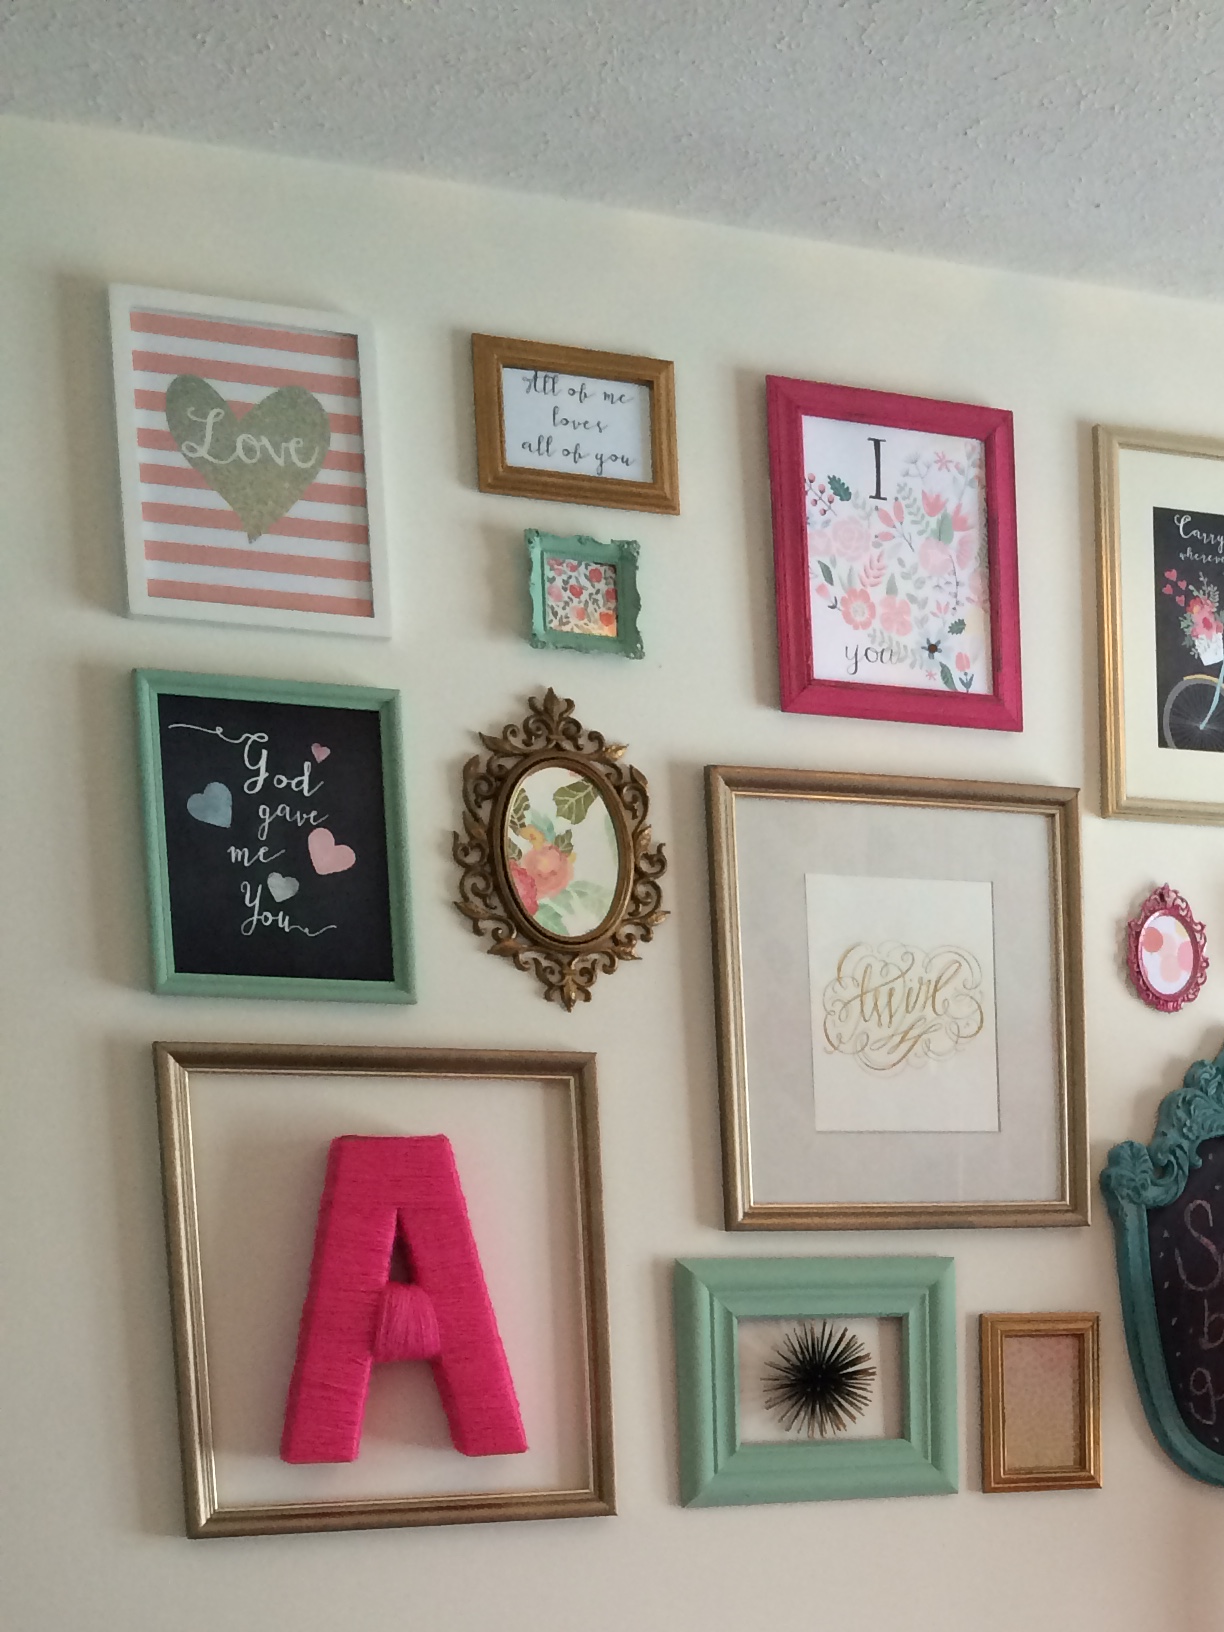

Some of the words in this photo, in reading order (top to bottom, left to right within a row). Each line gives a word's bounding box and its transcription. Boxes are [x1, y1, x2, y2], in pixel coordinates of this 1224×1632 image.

[522, 370, 562, 396] All
[567, 383, 596, 403] of
[603, 391, 635, 404] me
[181, 408, 320, 469] Love
[552, 405, 609, 433] loves
[521, 434, 558, 457] all
[562, 443, 590, 464] of
[595, 452, 637, 476] you
[867, 437, 888, 501] I
[845, 644, 897, 675] you
[213, 726, 325, 797] God
[258, 803, 329, 841] gave
[227, 845, 286, 867] me
[240, 881, 328, 936] You
[280, 1133, 529, 1464] A
